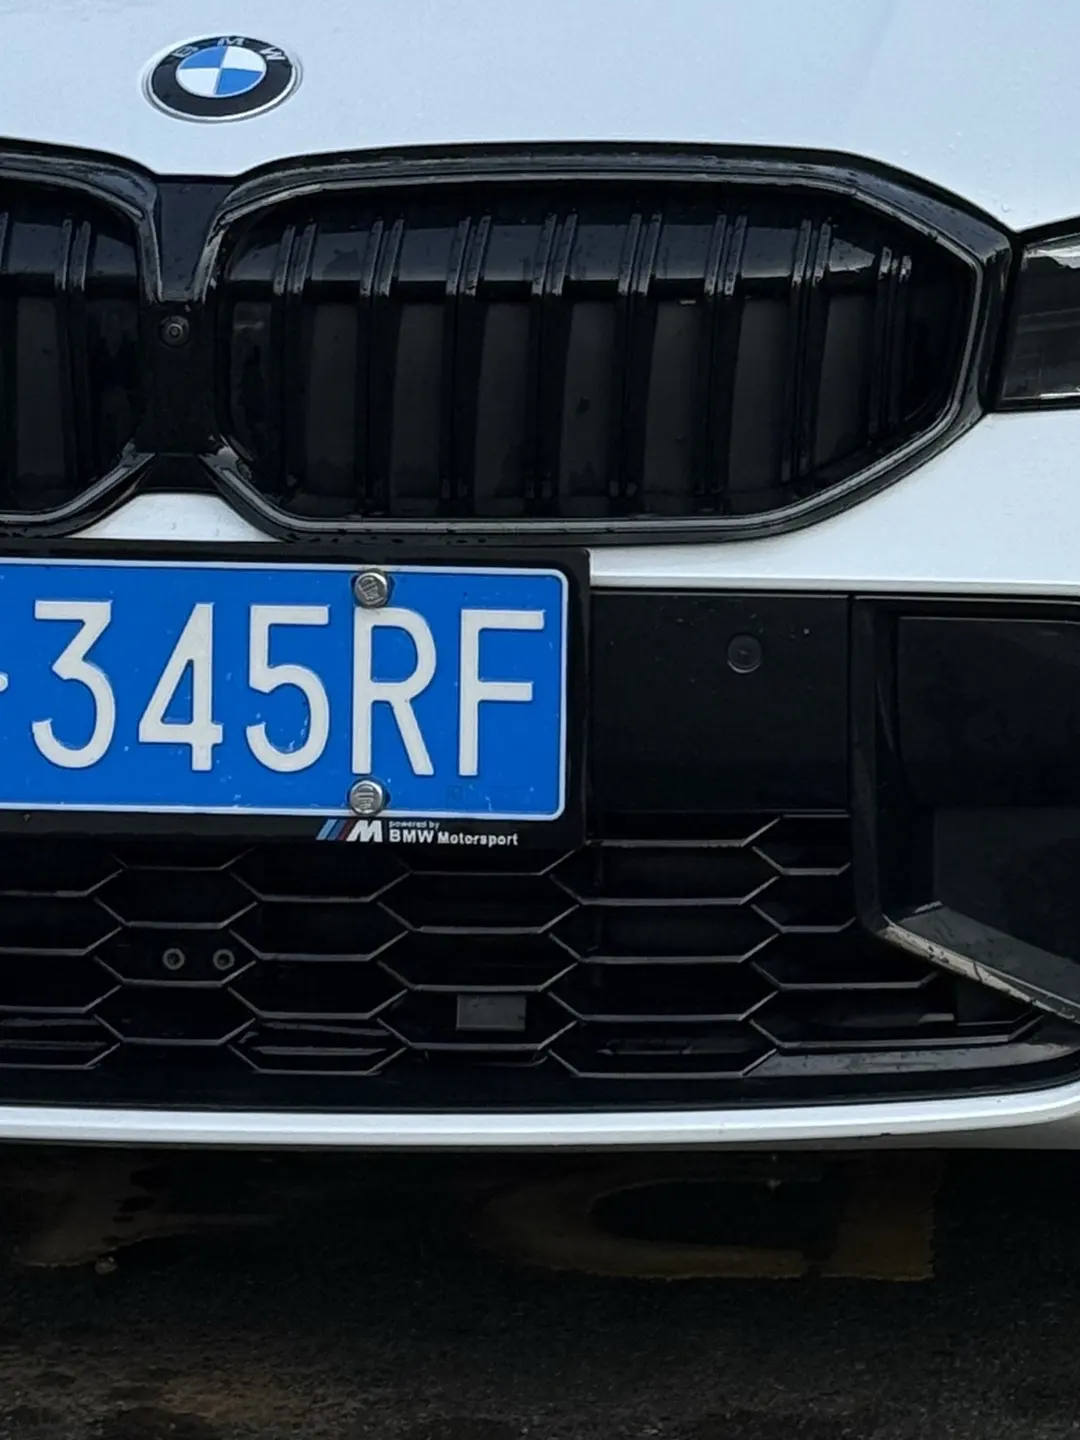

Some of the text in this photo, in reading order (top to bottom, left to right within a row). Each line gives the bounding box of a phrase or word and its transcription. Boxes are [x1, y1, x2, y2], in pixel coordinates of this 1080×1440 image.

[171, 36, 287, 61] BMW
[31, 599, 546, 776] 345RF
[428, 821, 440, 830] by
[388, 829, 519, 847] BMW Motorsport
